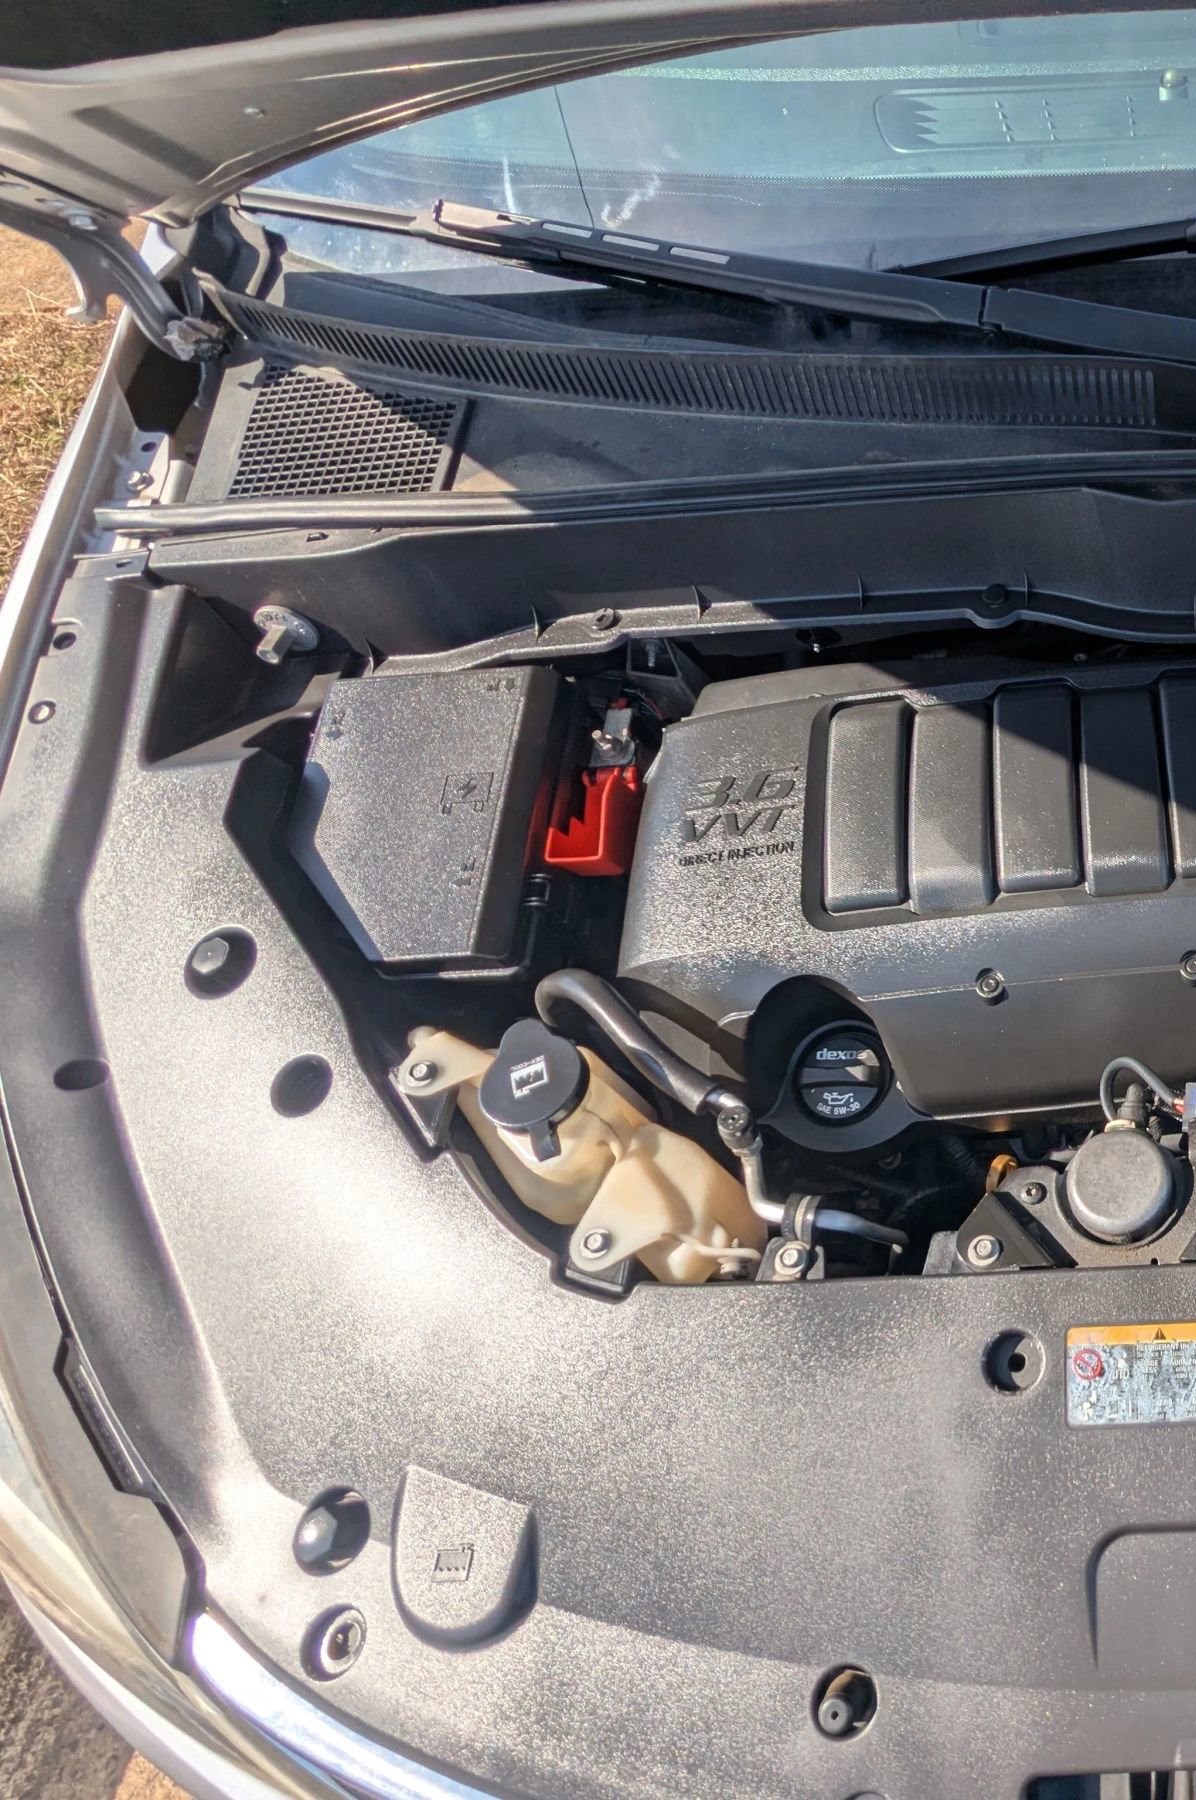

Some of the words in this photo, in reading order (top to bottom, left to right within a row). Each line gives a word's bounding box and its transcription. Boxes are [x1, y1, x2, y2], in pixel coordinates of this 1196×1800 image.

[684, 766, 799, 814] 3.6
[681, 804, 796, 842] VVT
[679, 849, 726, 867] DIRECT
[727, 841, 795, 861] INJECTION
[816, 1047, 867, 1061] dexos
[816, 1102, 832, 1114] SAE
[833, 1101, 861, 1115] 5W-30
